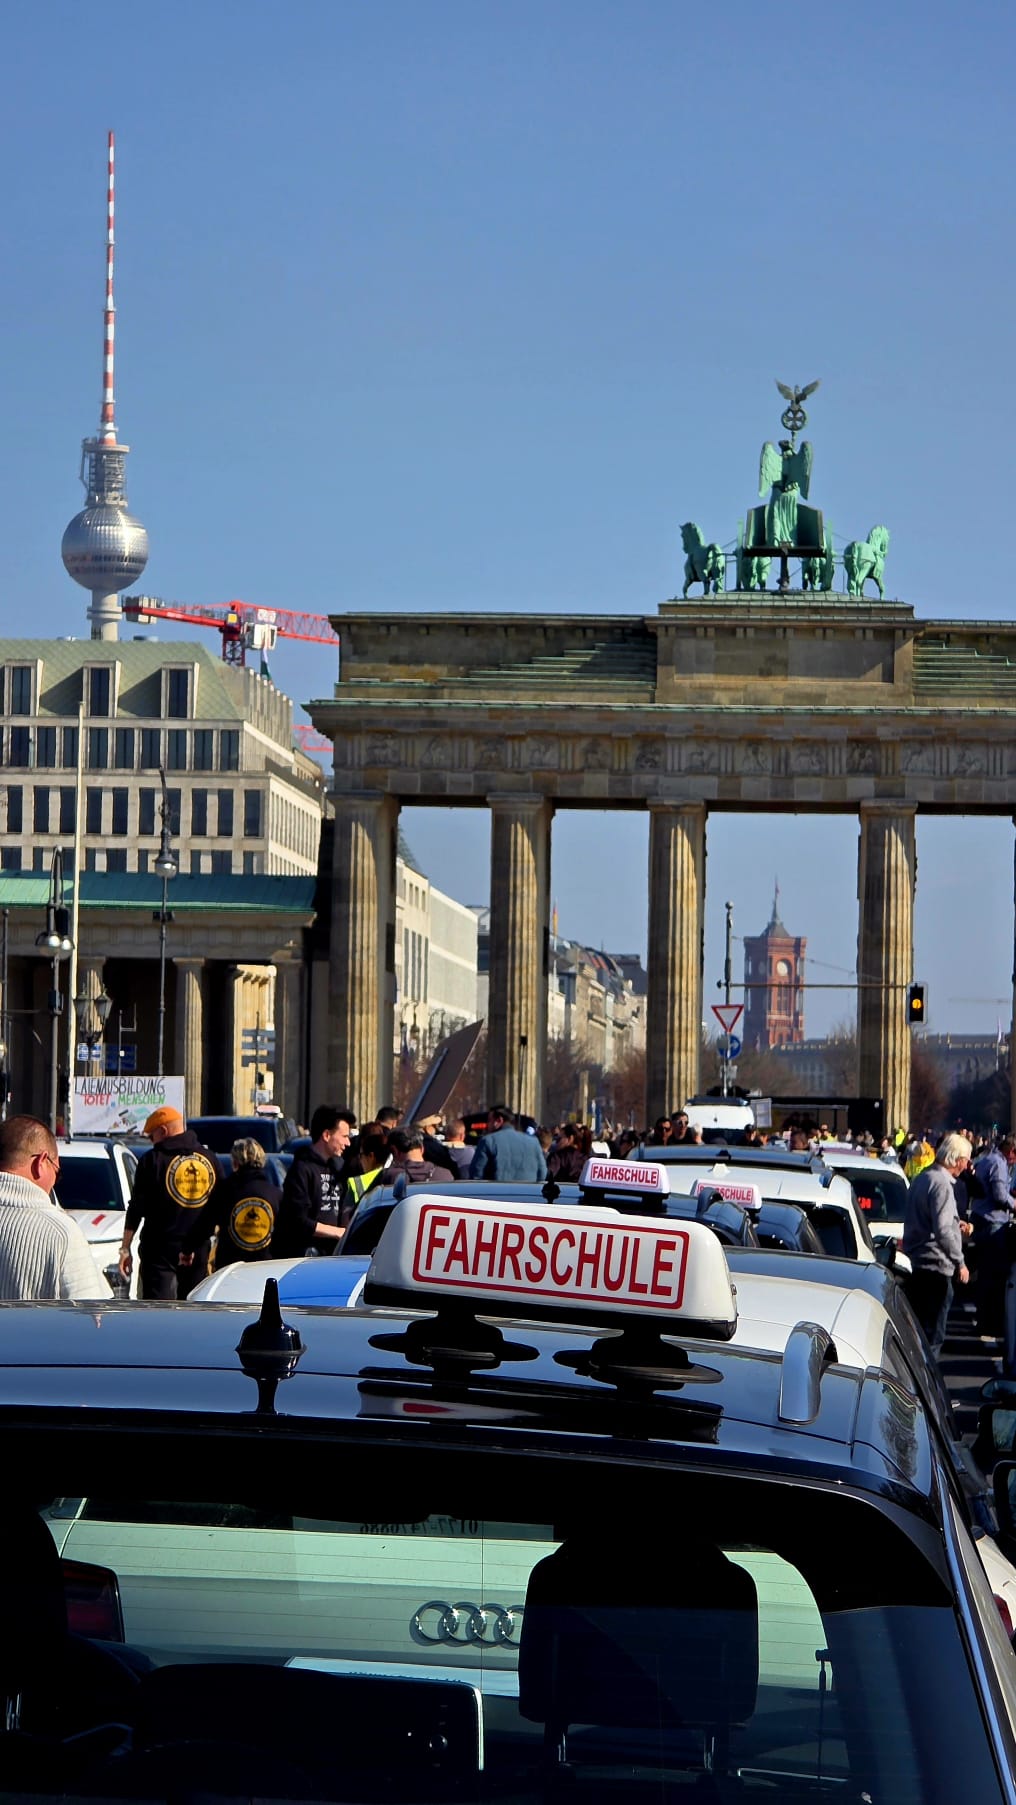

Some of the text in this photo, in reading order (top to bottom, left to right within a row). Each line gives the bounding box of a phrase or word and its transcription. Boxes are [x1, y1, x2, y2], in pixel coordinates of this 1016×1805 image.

[75, 1076, 165, 1096] LAIENAUSBILDUNG
[118, 1094, 165, 1105] MENSCHEN
[592, 1166, 657, 1184] FAHRSCHULE
[425, 1216, 676, 1296] FAHRSCHULE
